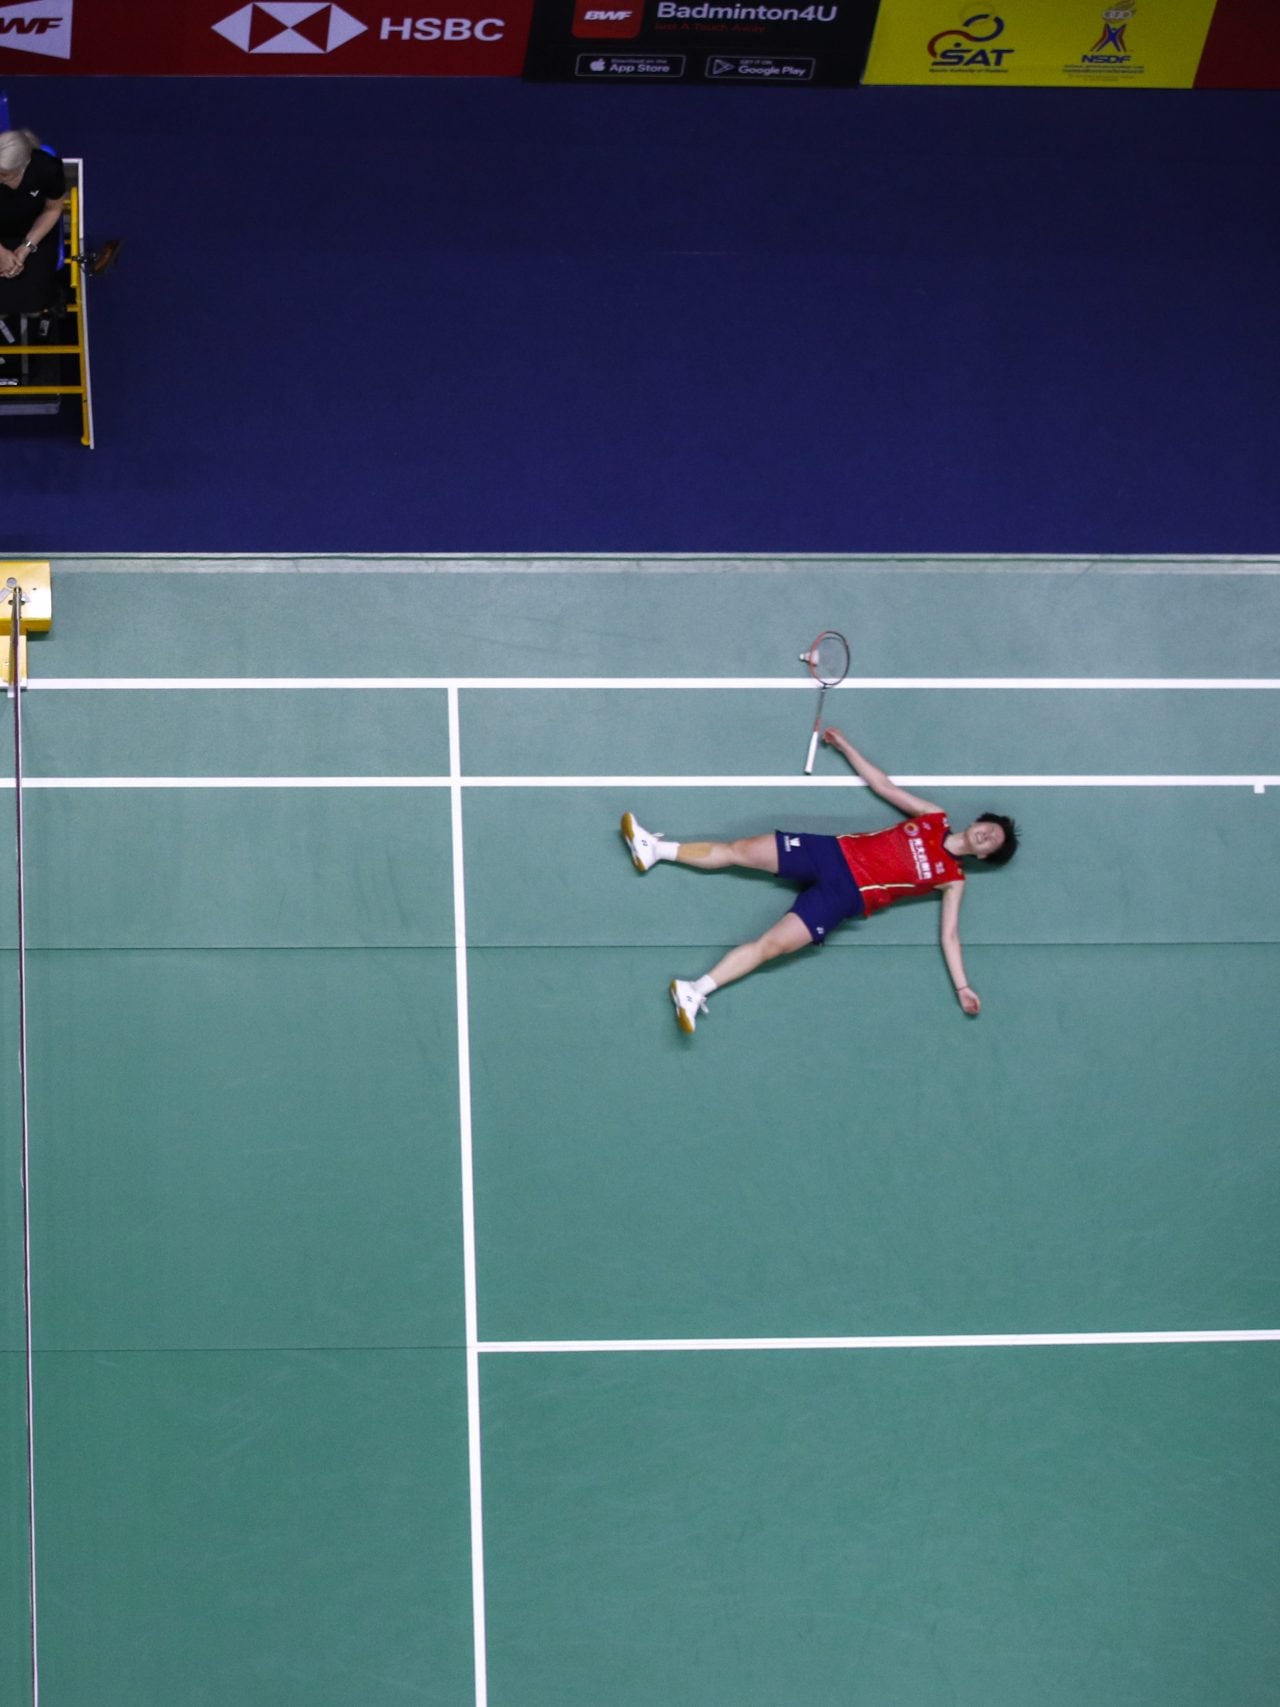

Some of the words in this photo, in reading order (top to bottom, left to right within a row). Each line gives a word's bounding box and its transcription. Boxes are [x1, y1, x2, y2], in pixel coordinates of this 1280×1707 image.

[584, 10, 633, 21] BWF
[657, 1, 838, 22] Badminton4U
[379, 17, 505, 41] HSBC
[931, 49, 1015, 66] SAT
[1081, 54, 1132, 63] NSDF
[609, 64, 635, 73] App
[637, 64, 670, 73] Store
[738, 65, 780, 76] Google
[782, 66, 806, 76] Play
